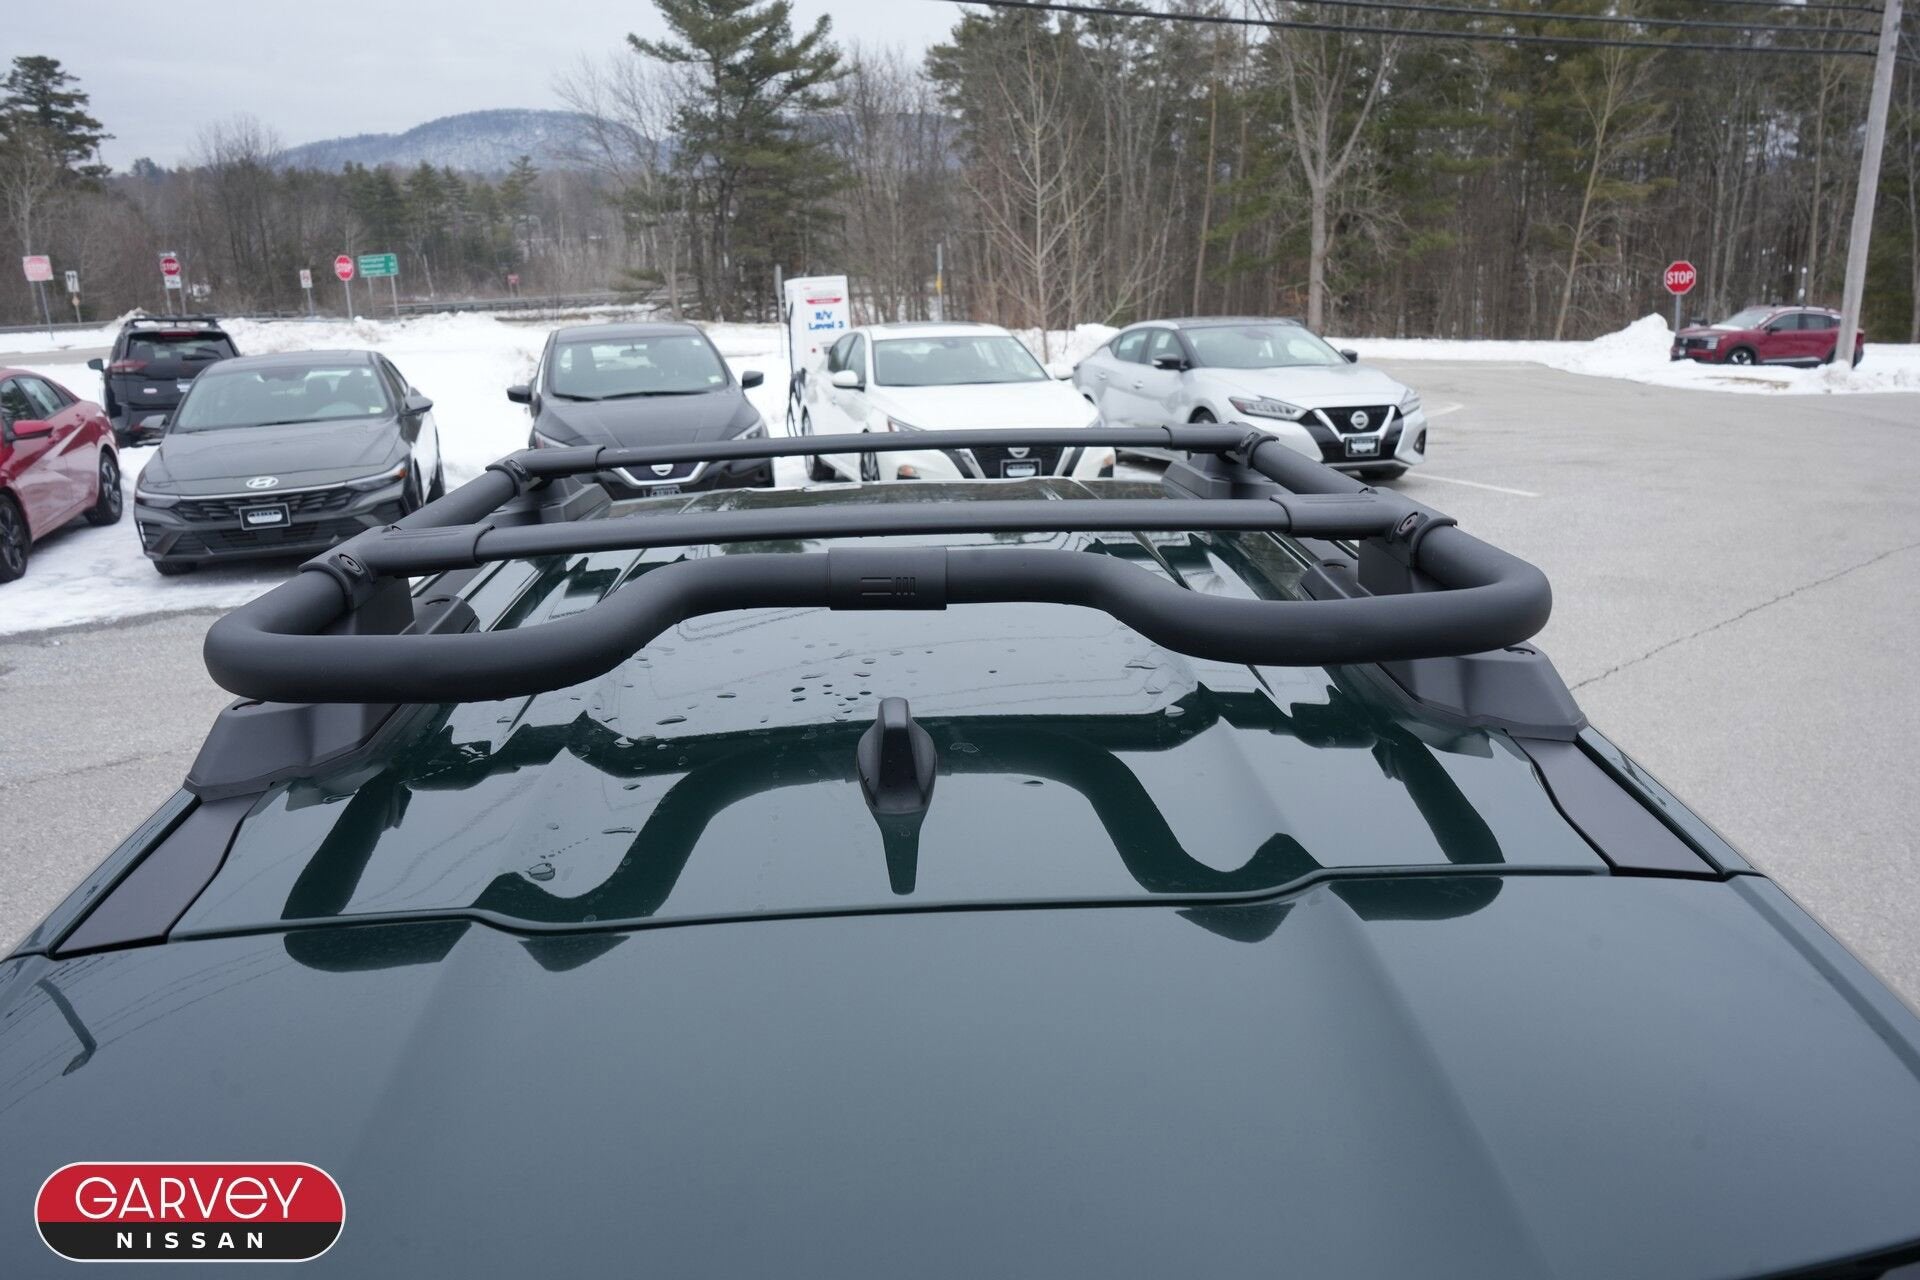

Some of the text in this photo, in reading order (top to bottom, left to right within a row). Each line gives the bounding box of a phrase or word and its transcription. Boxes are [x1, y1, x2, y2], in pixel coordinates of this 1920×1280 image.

[161, 262, 180, 271] STOP
[1667, 270, 1694, 285] STOP
[808, 320, 834, 330] Level
